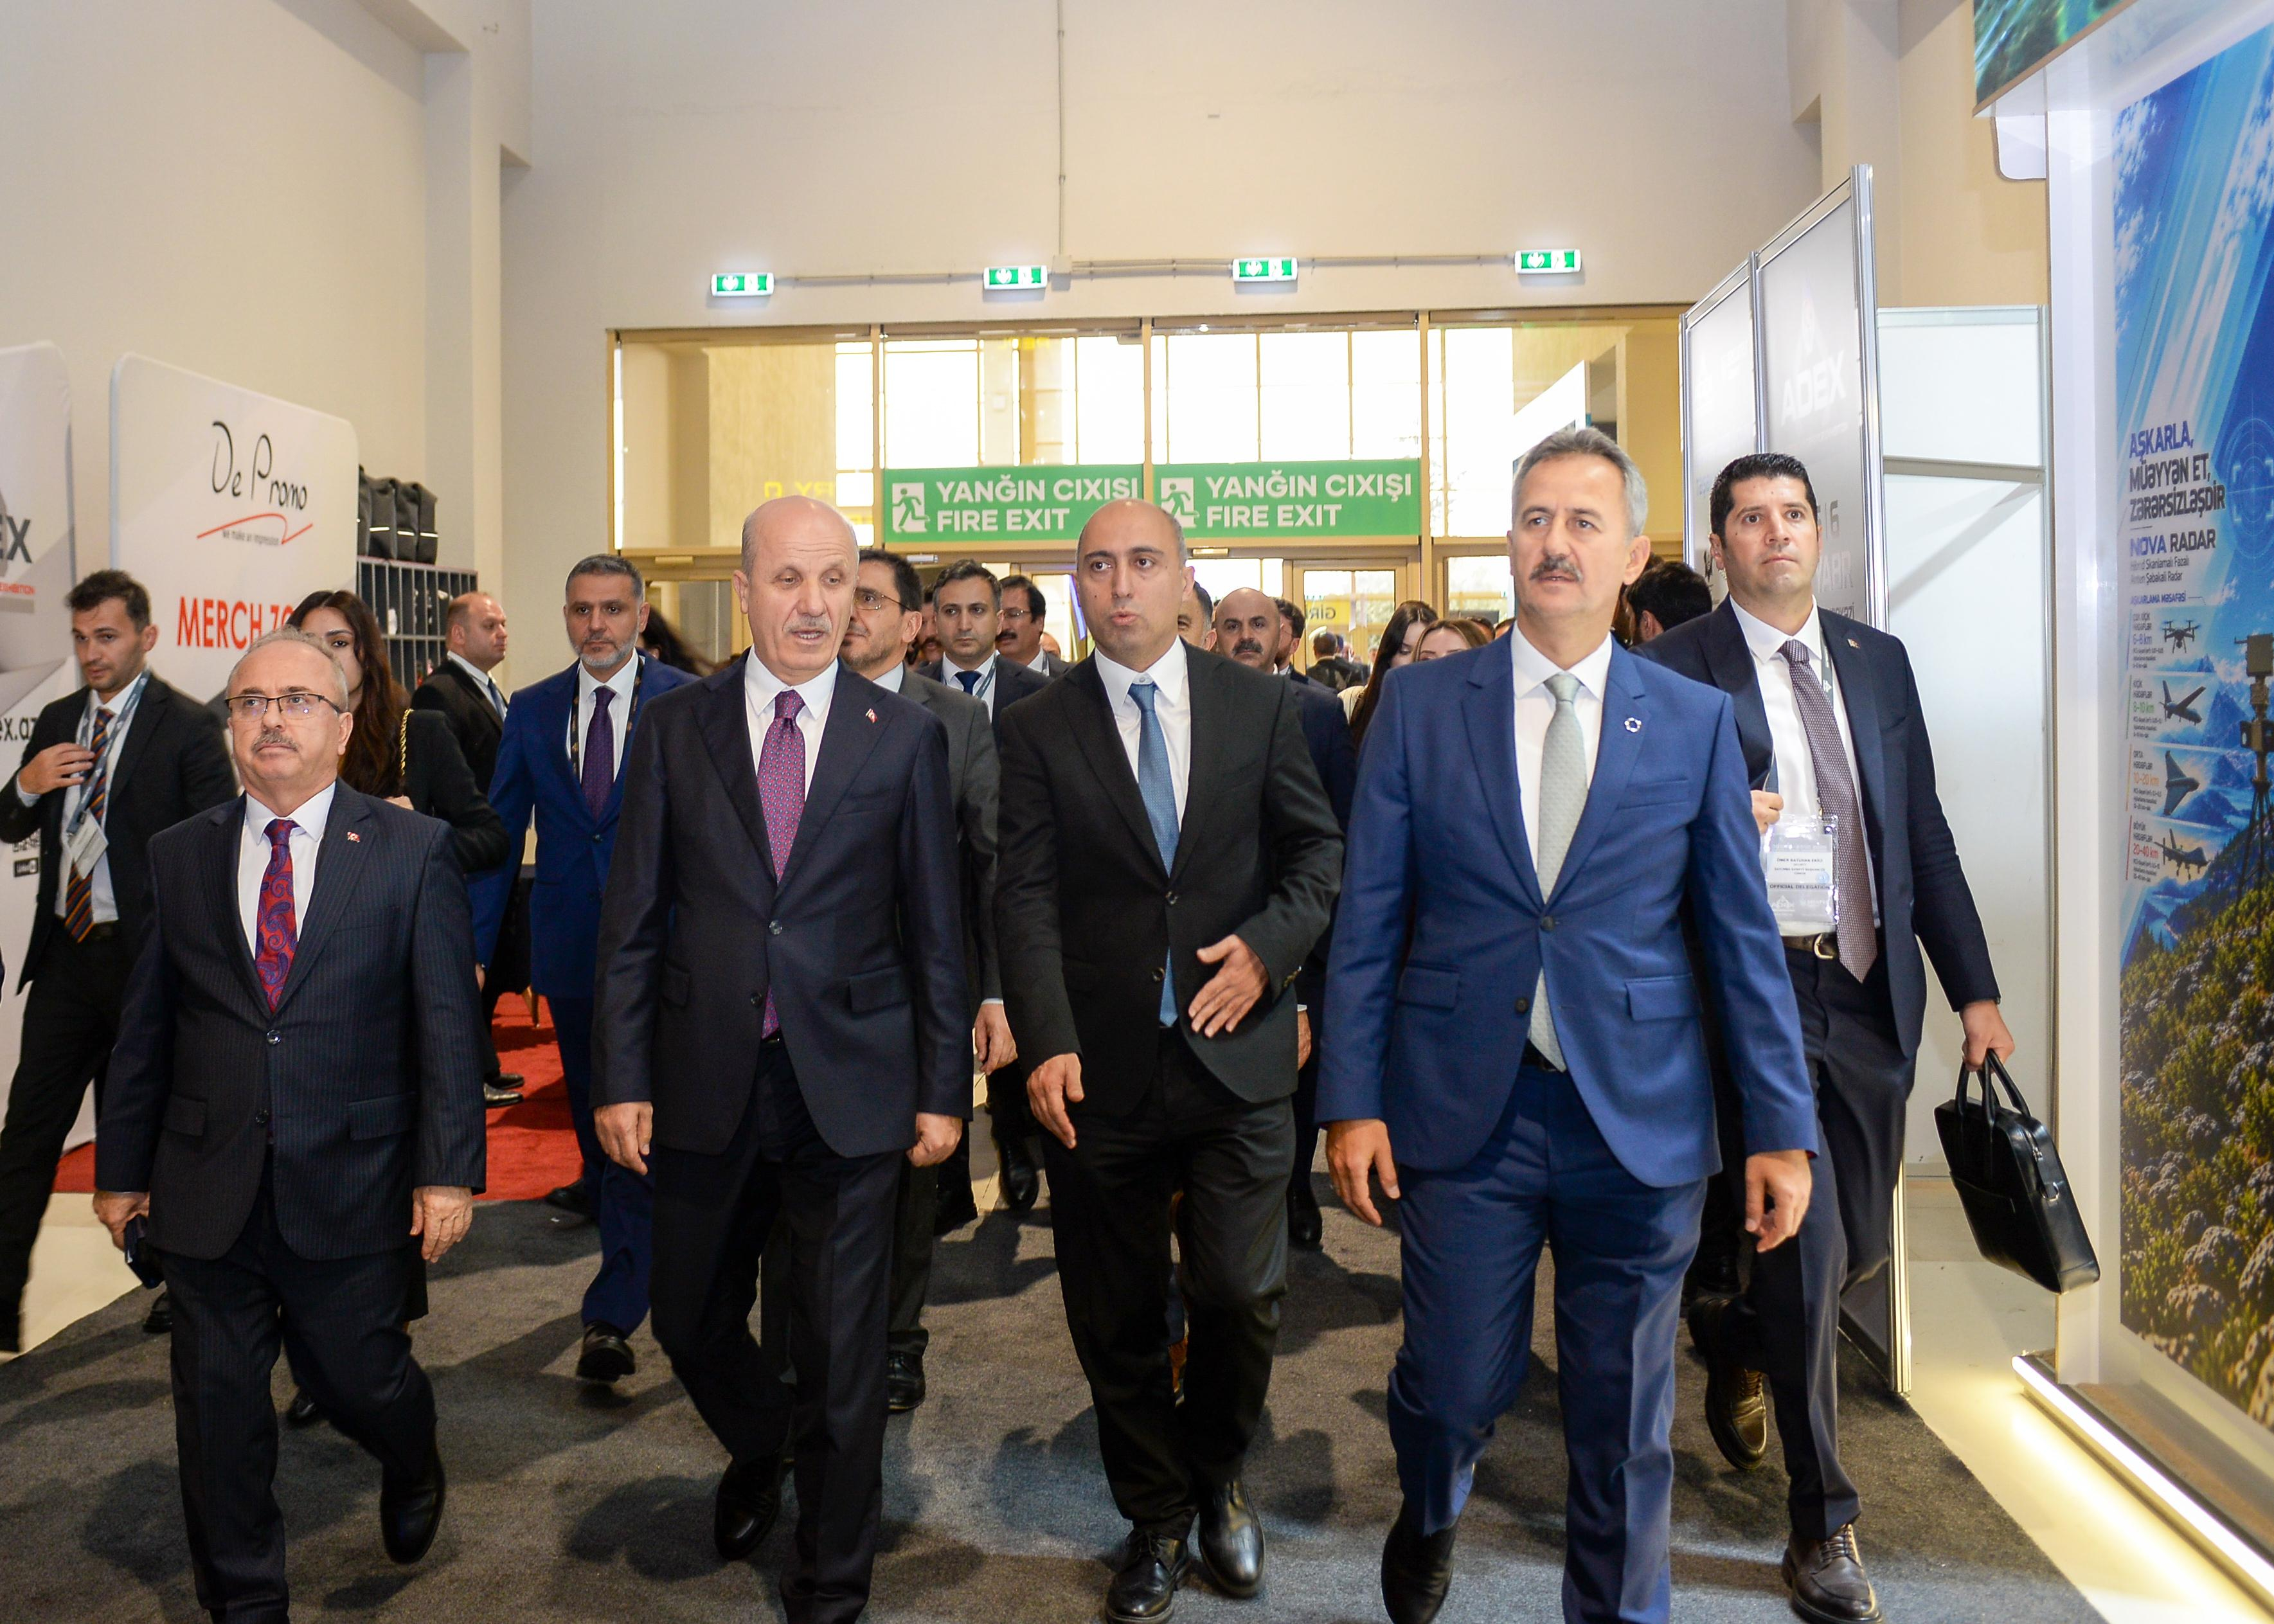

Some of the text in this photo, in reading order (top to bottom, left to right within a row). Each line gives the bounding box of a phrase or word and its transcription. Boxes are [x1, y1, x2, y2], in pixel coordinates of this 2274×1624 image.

[1780, 349, 1847, 427] ADEX
[2129, 420, 2194, 462] AŞKARLA,
[212, 420, 241, 497] De
[2193, 452, 2210, 482] ET,
[936, 474, 1046, 503] YANĞIN
[1206, 469, 1317, 498] YANĞIN
[936, 508, 1070, 532] FIRE EXIT
[1206, 504, 1342, 528] FIRE EXIT
[0, 515, 32, 564] X
[2130, 528, 2216, 557] NOVA RADAR
[177, 596, 262, 650] MERCH
